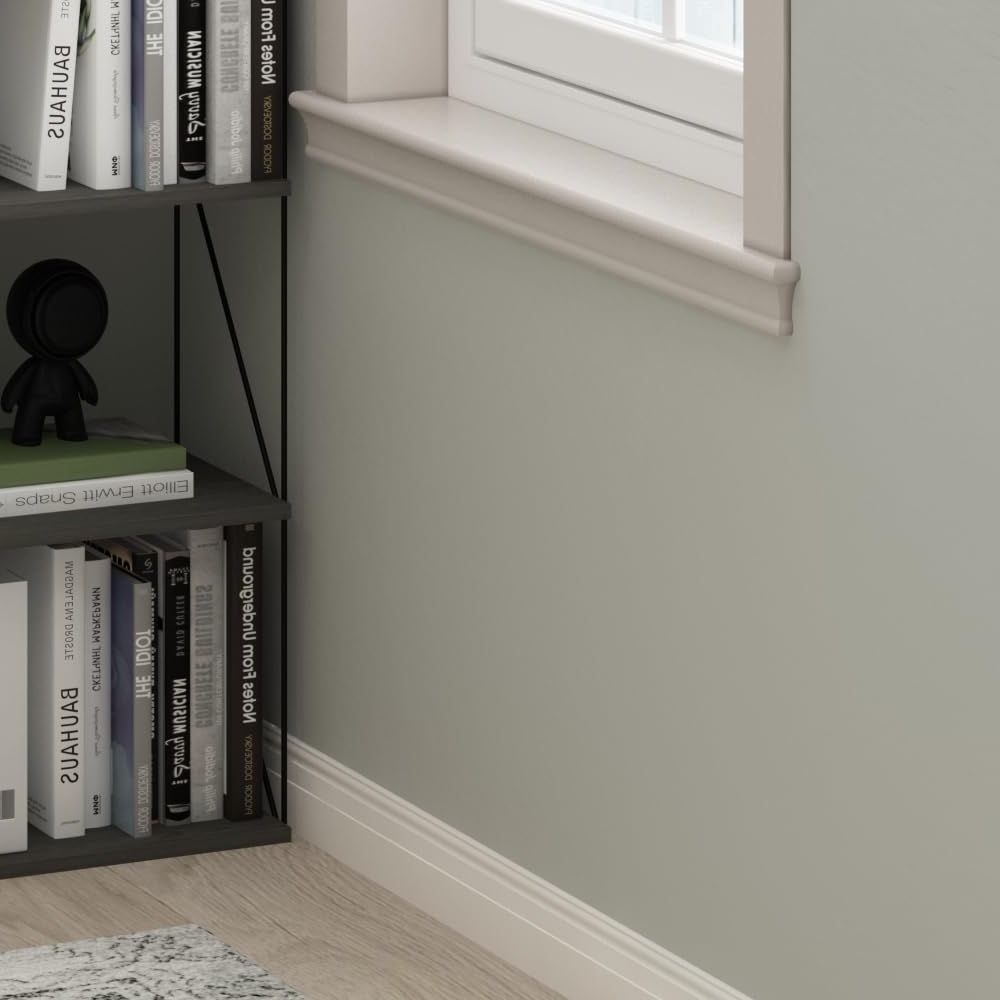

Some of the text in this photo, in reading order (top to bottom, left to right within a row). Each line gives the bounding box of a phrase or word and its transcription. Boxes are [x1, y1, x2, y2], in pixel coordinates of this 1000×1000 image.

[15, 480, 188, 508] Elliott Erwitt Snaps
